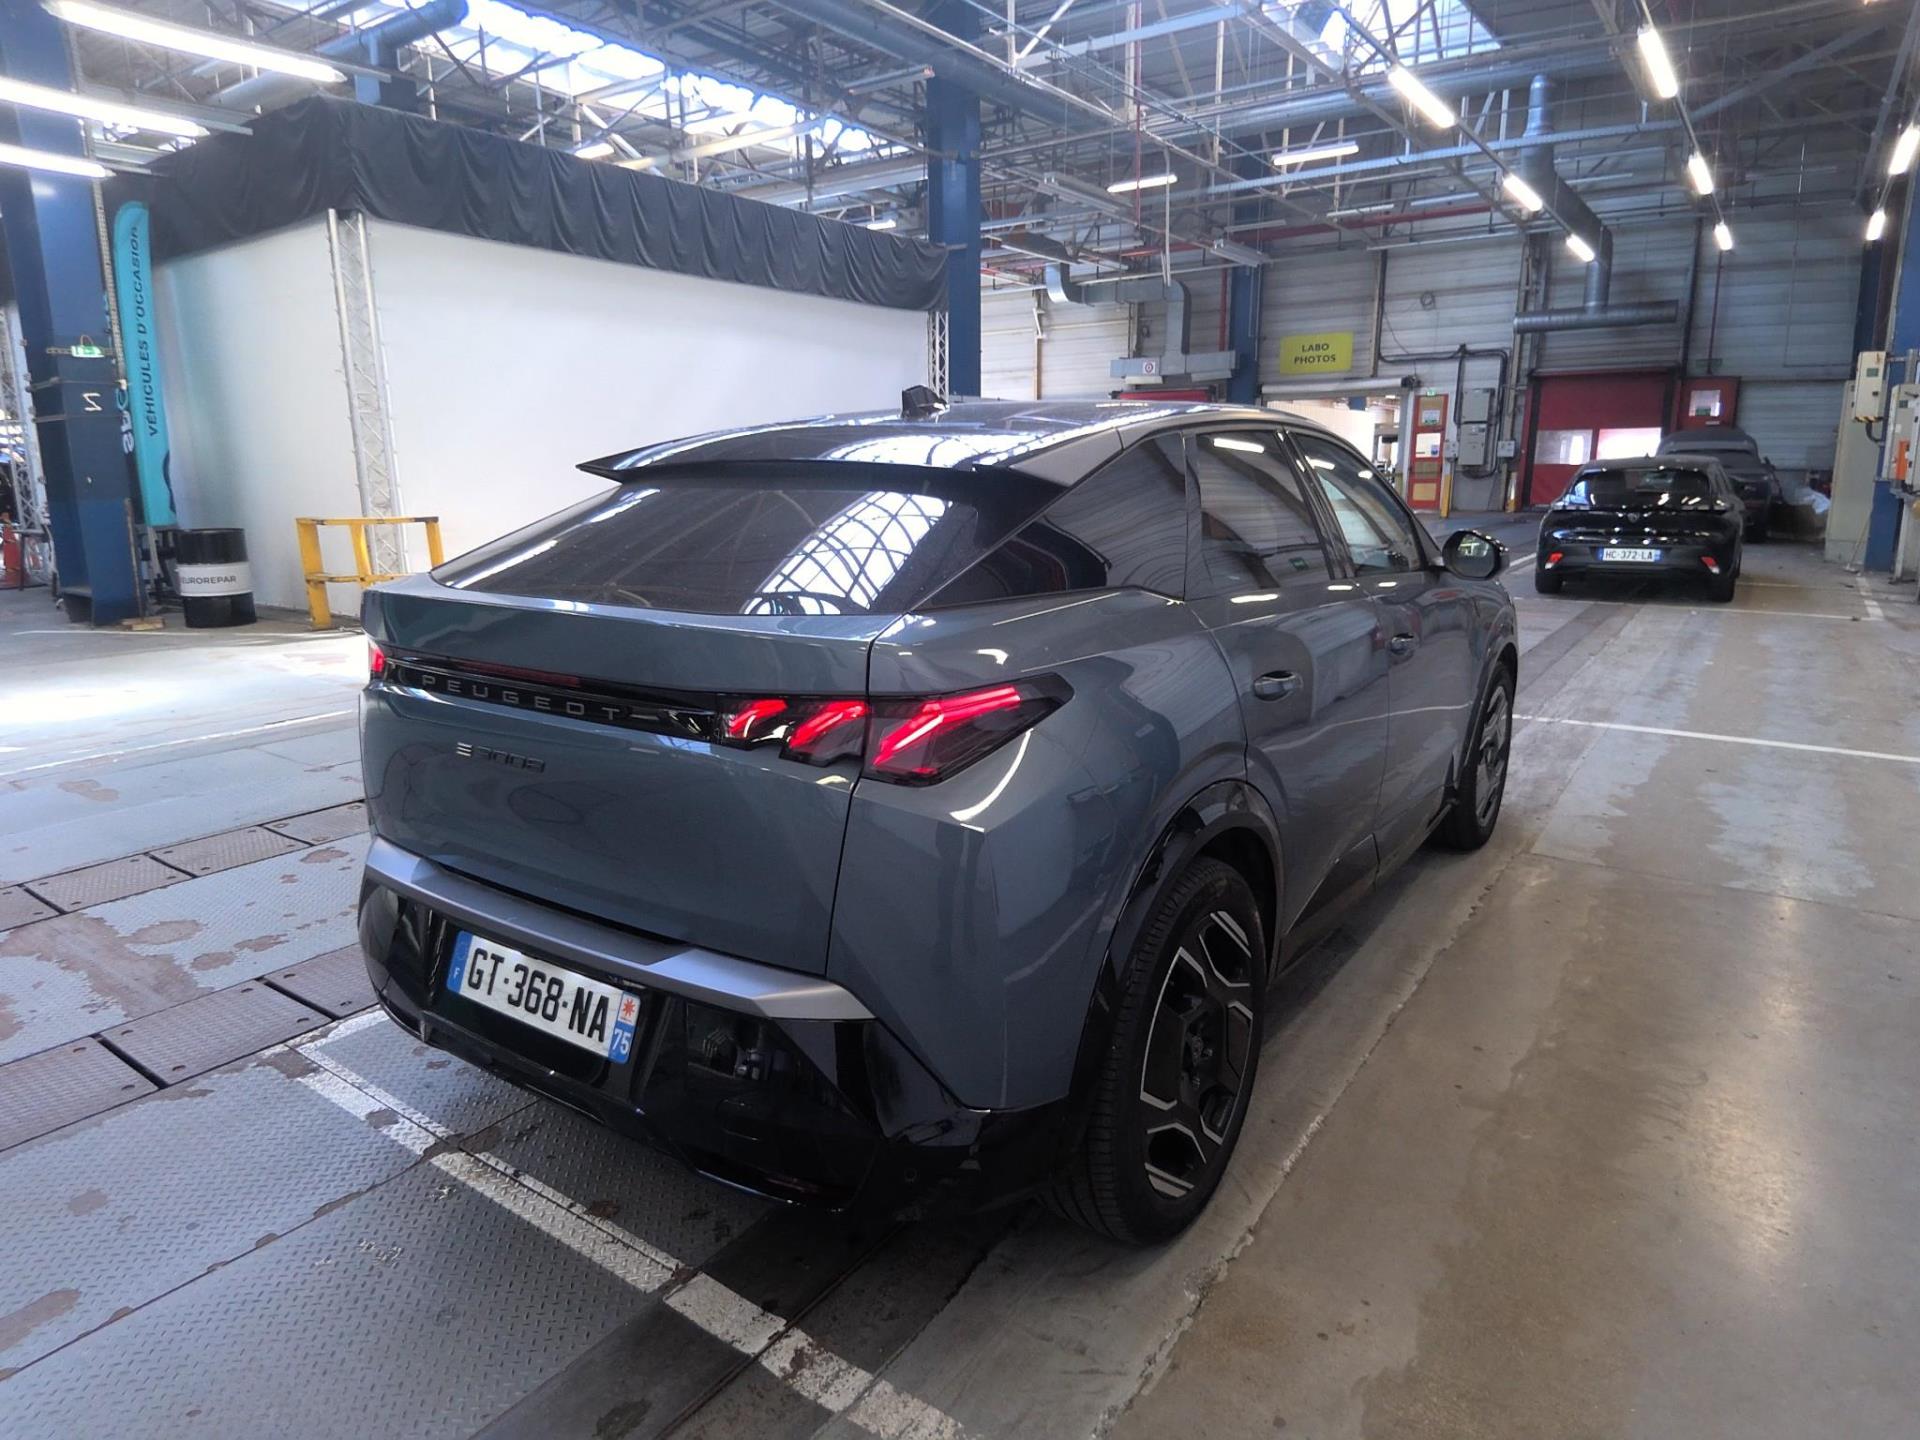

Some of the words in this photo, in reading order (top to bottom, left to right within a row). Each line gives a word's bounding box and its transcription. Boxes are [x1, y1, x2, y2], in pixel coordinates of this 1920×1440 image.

[1301, 343, 1330, 352] LABO
[1294, 354, 1336, 364] PHOTOS
[422, 674, 620, 721] PEUGEOT
[612, 1028, 631, 1055] 75
